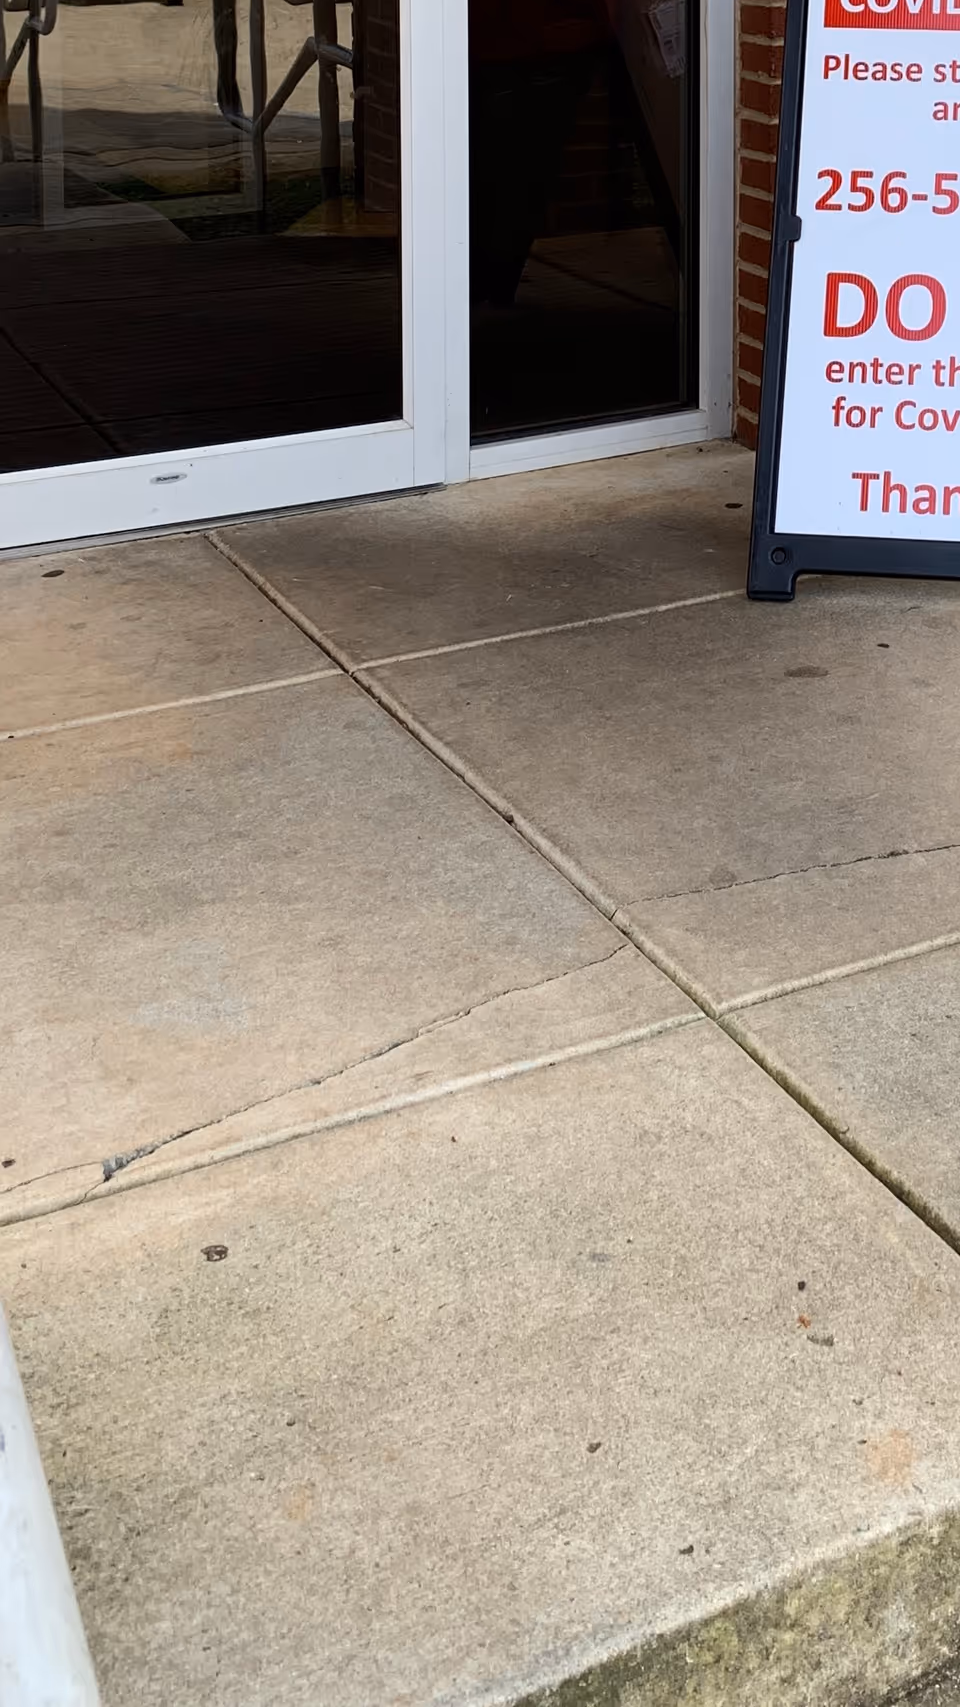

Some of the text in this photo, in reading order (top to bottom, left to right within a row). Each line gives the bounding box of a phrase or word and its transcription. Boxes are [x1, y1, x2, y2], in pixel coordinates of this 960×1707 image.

[822, 54, 924, 84] Please
[823, 272, 948, 342] DO
[824, 357, 920, 386] enter
[831, 396, 883, 429] for
